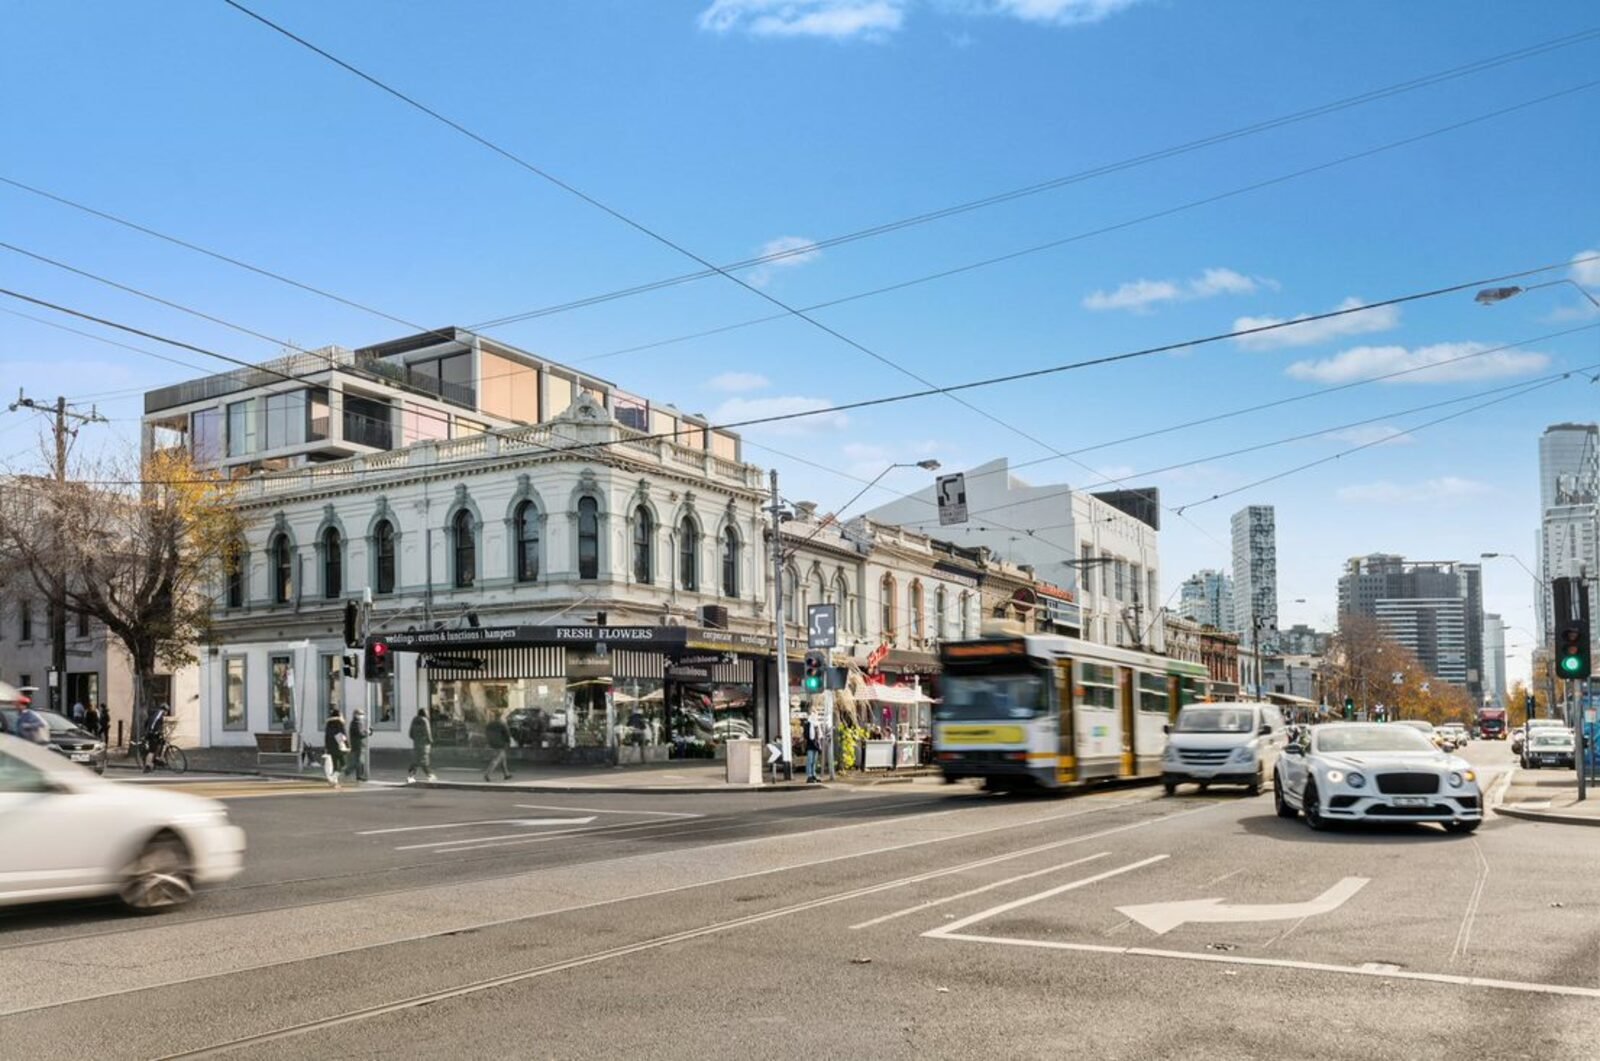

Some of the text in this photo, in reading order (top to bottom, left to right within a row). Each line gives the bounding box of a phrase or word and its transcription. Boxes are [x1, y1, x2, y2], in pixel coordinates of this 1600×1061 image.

[484, 628, 516, 640] hampers
[556, 628, 653, 640] FRESH FLOWERS
